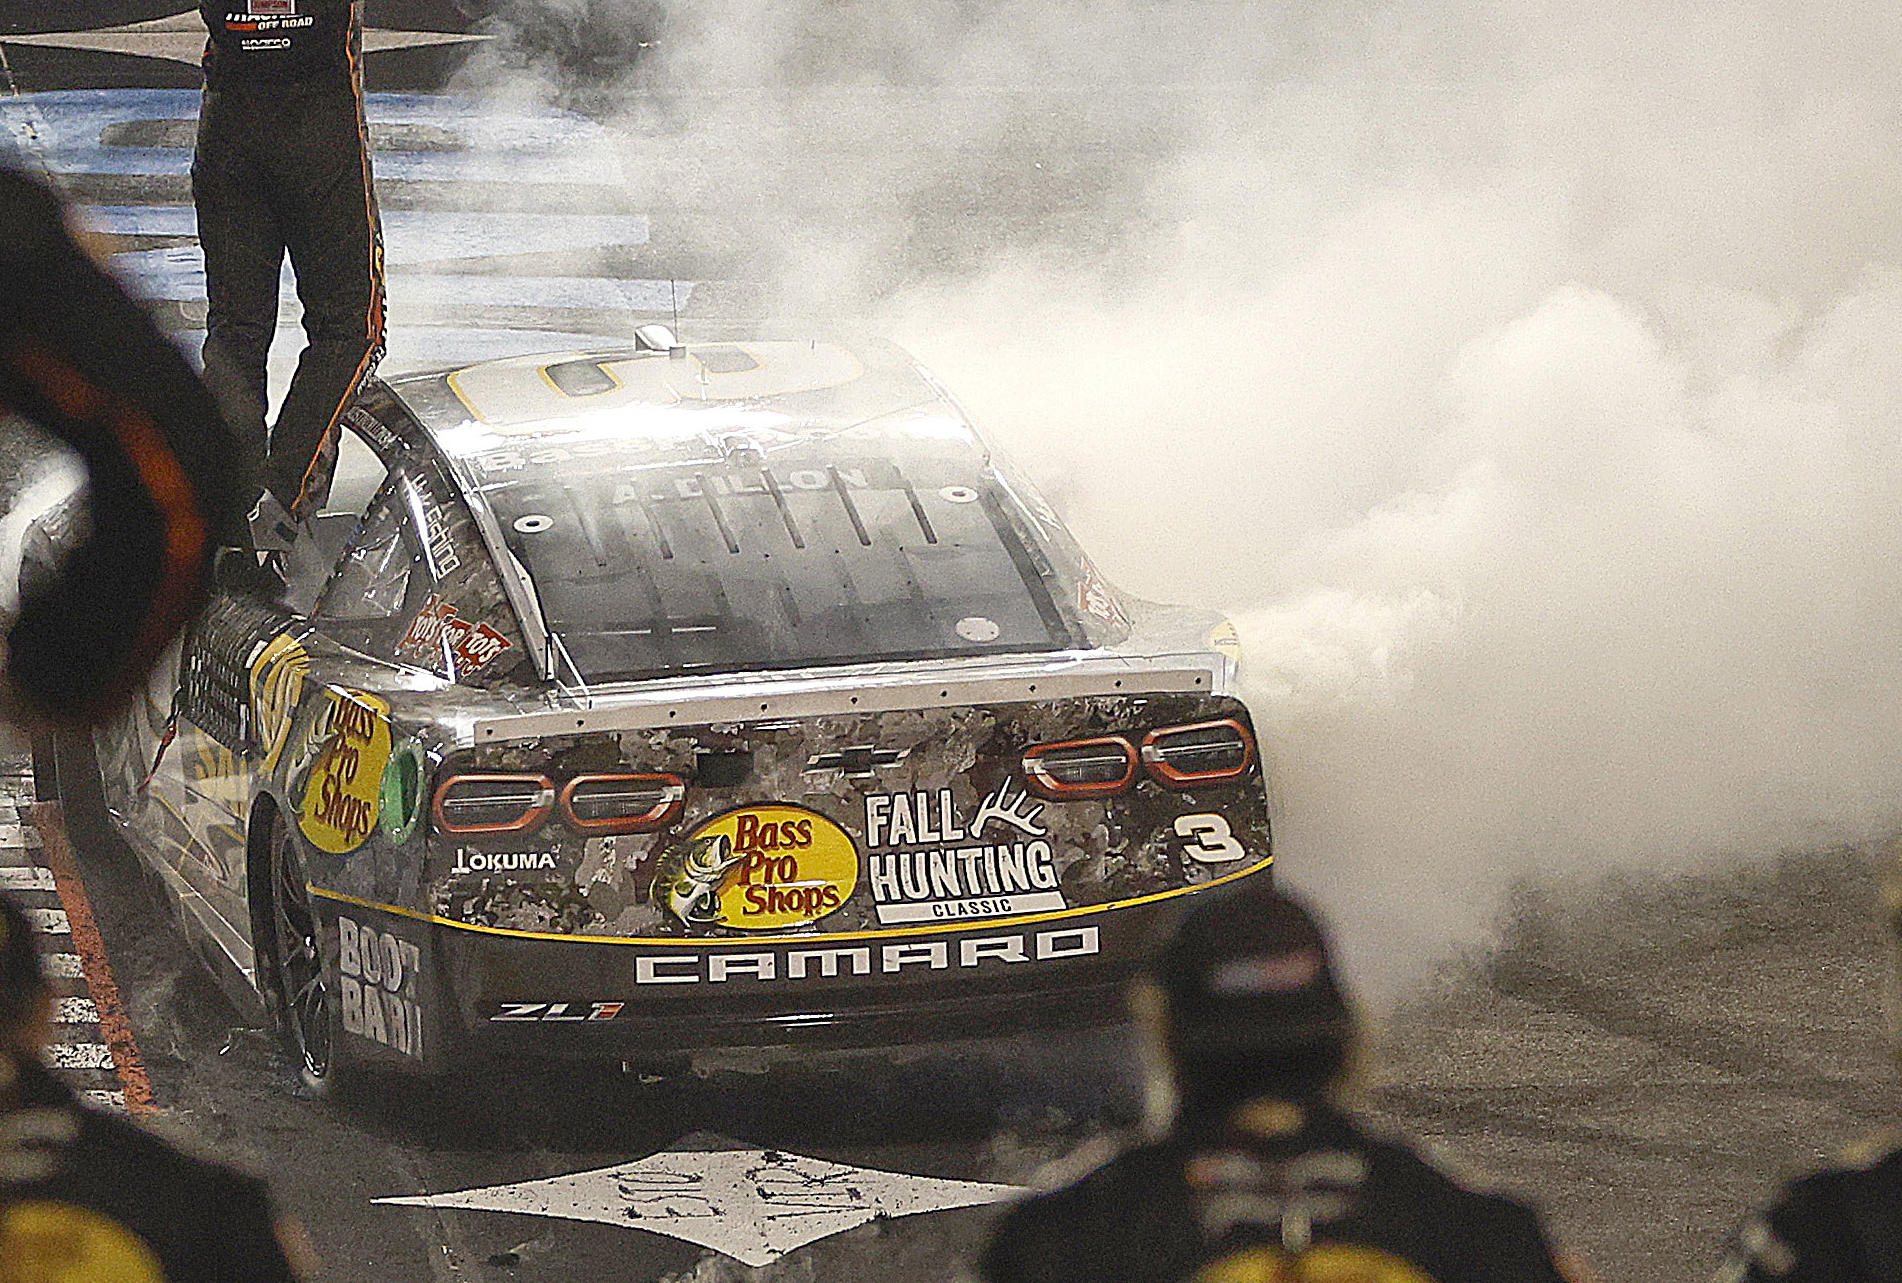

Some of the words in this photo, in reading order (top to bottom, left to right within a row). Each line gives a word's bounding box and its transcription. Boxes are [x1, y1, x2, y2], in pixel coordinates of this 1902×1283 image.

[258, 21, 280, 31] OFF
[282, 16, 314, 29] ROAD
[321, 734, 359, 790] Pro
[313, 774, 372, 845] Shops
[733, 815, 812, 853] Bass
[866, 789, 964, 847] FALL
[1174, 815, 1245, 864] 3
[740, 851, 799, 887] Pro
[869, 840, 1055, 903] HUNTING
[742, 884, 842, 917] Shops
[932, 897, 1013, 918] CLASSIC
[339, 916, 421, 993] BOOT
[635, 925, 1101, 984] CAMARO
[490, 1002, 625, 1022] ZL1
